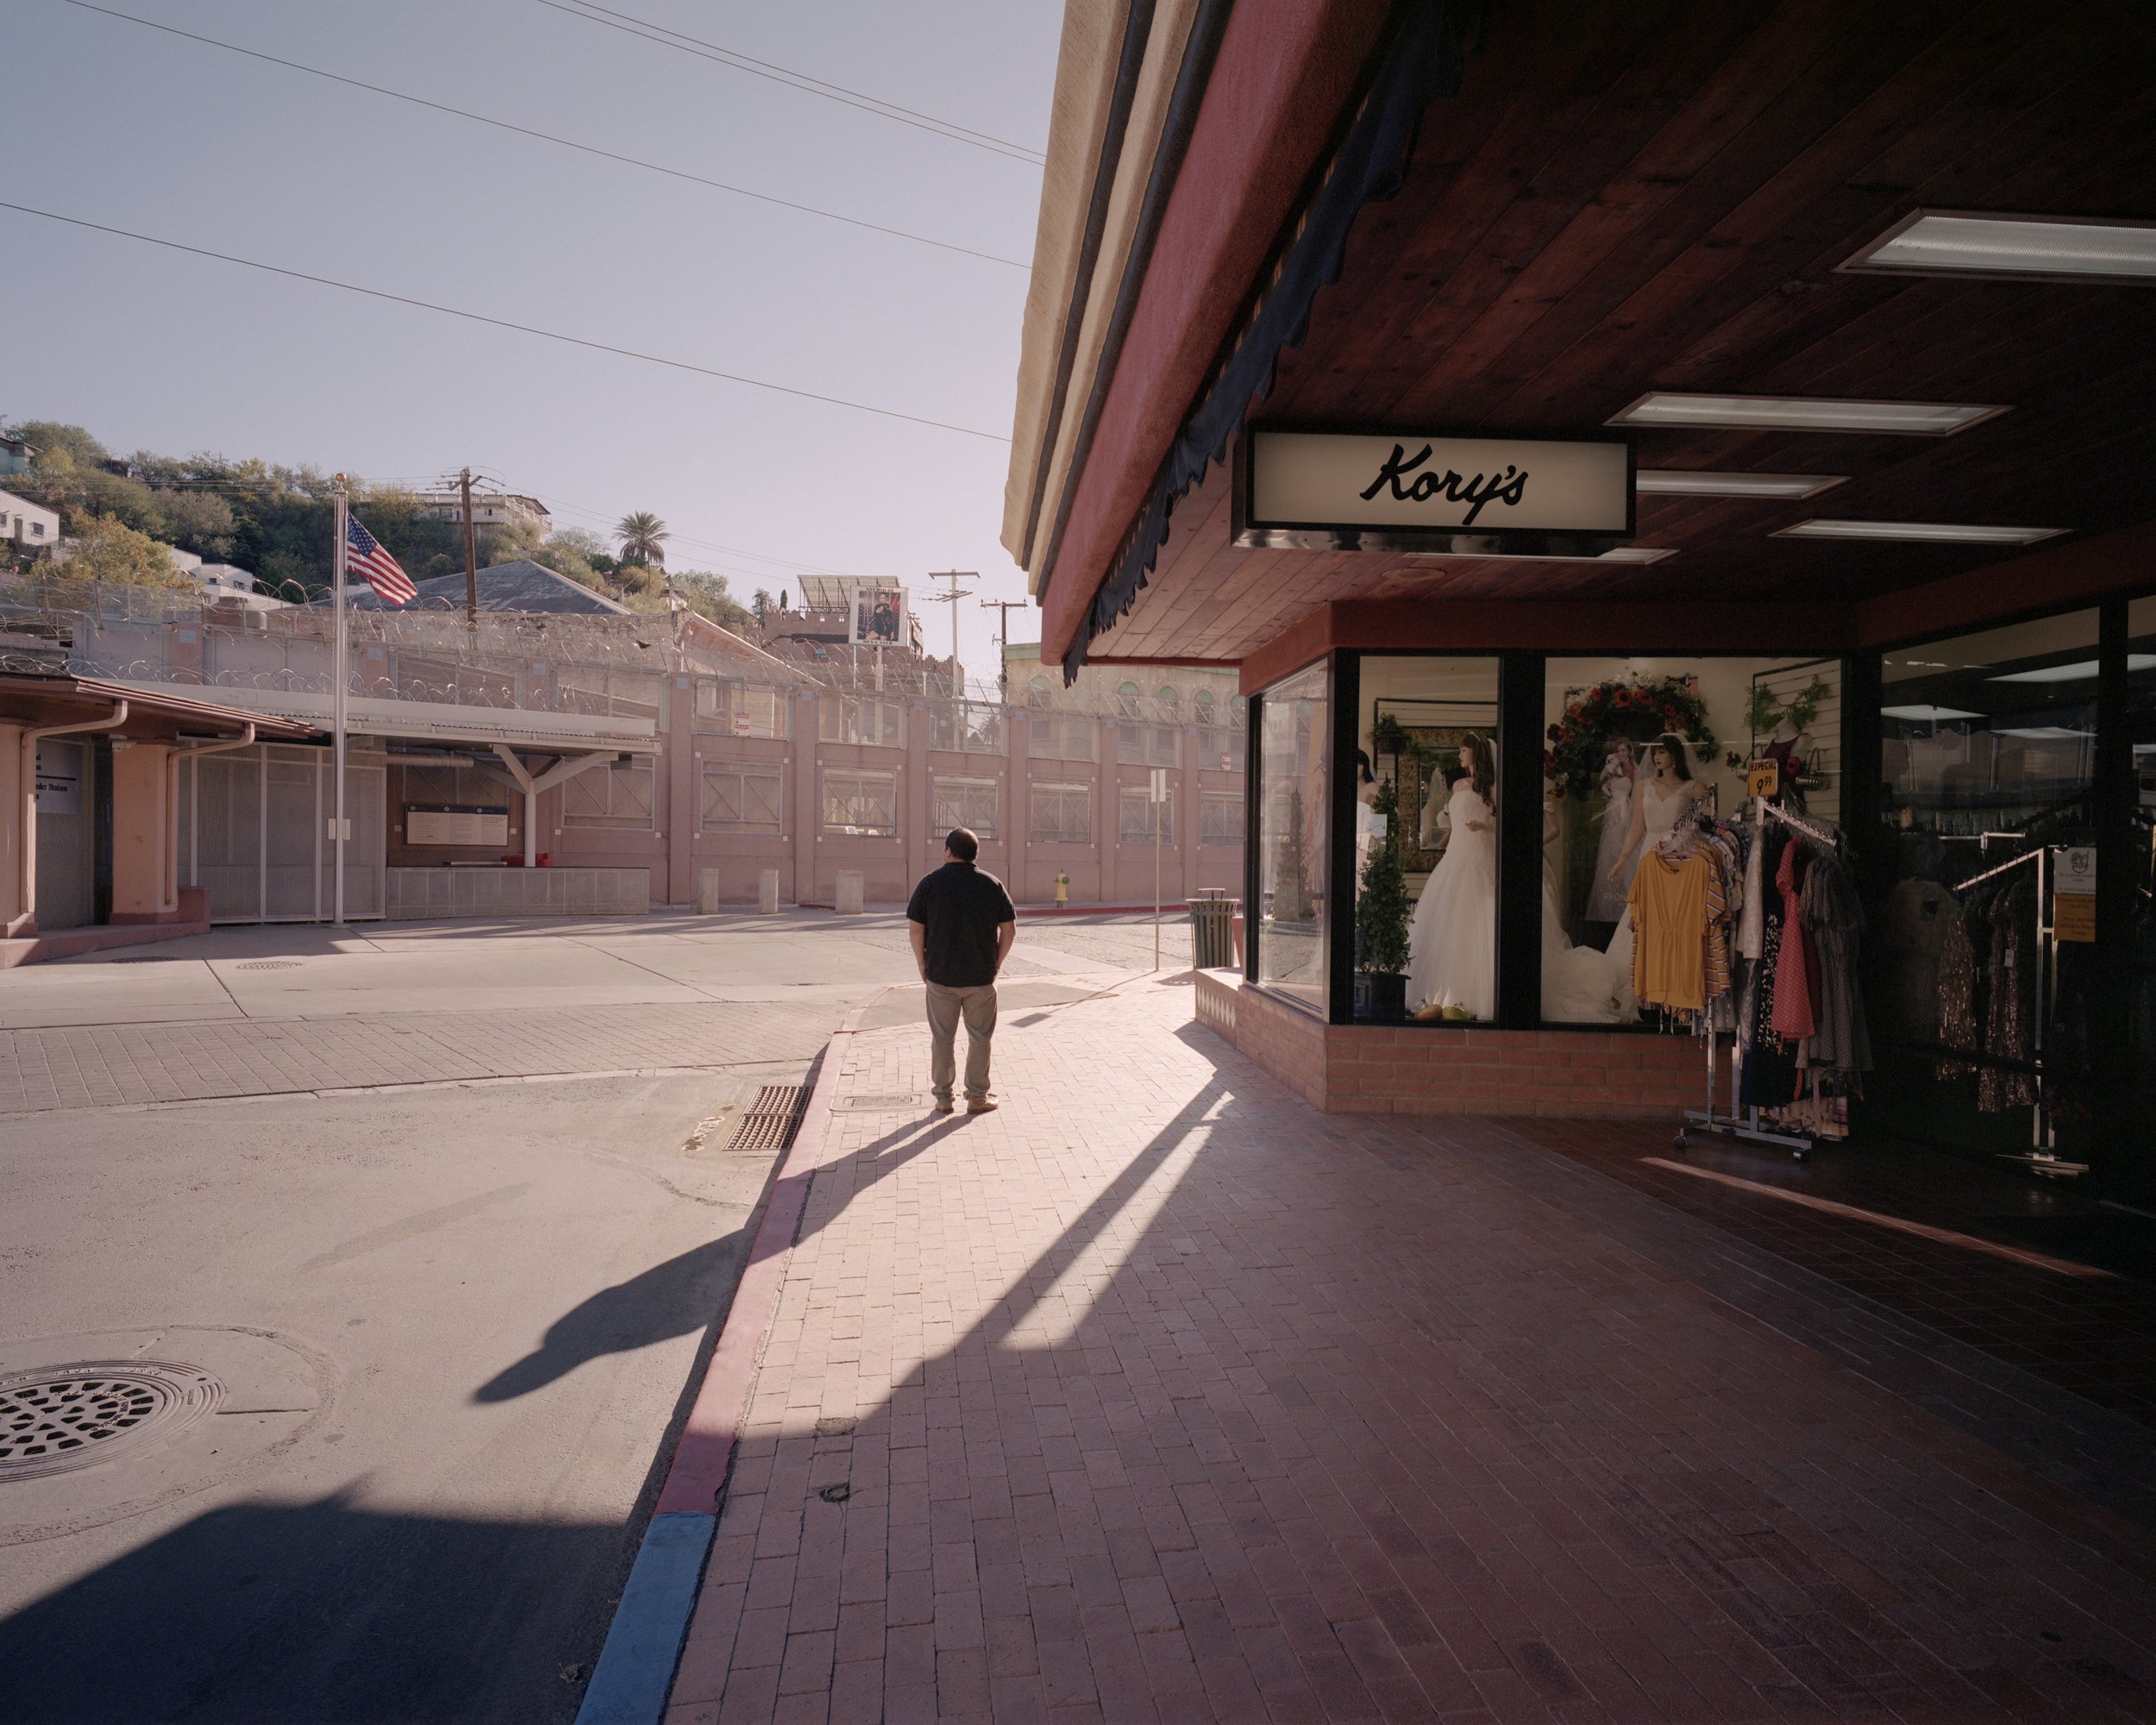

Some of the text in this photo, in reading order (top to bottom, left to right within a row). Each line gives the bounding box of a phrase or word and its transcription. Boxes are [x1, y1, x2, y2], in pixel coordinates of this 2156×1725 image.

[1359, 442, 1530, 526] Kory's
[1751, 761, 1777, 771] ESPECIAL
[48, 783, 68, 792] Station
[1604, 892, 1627, 901] PRON
